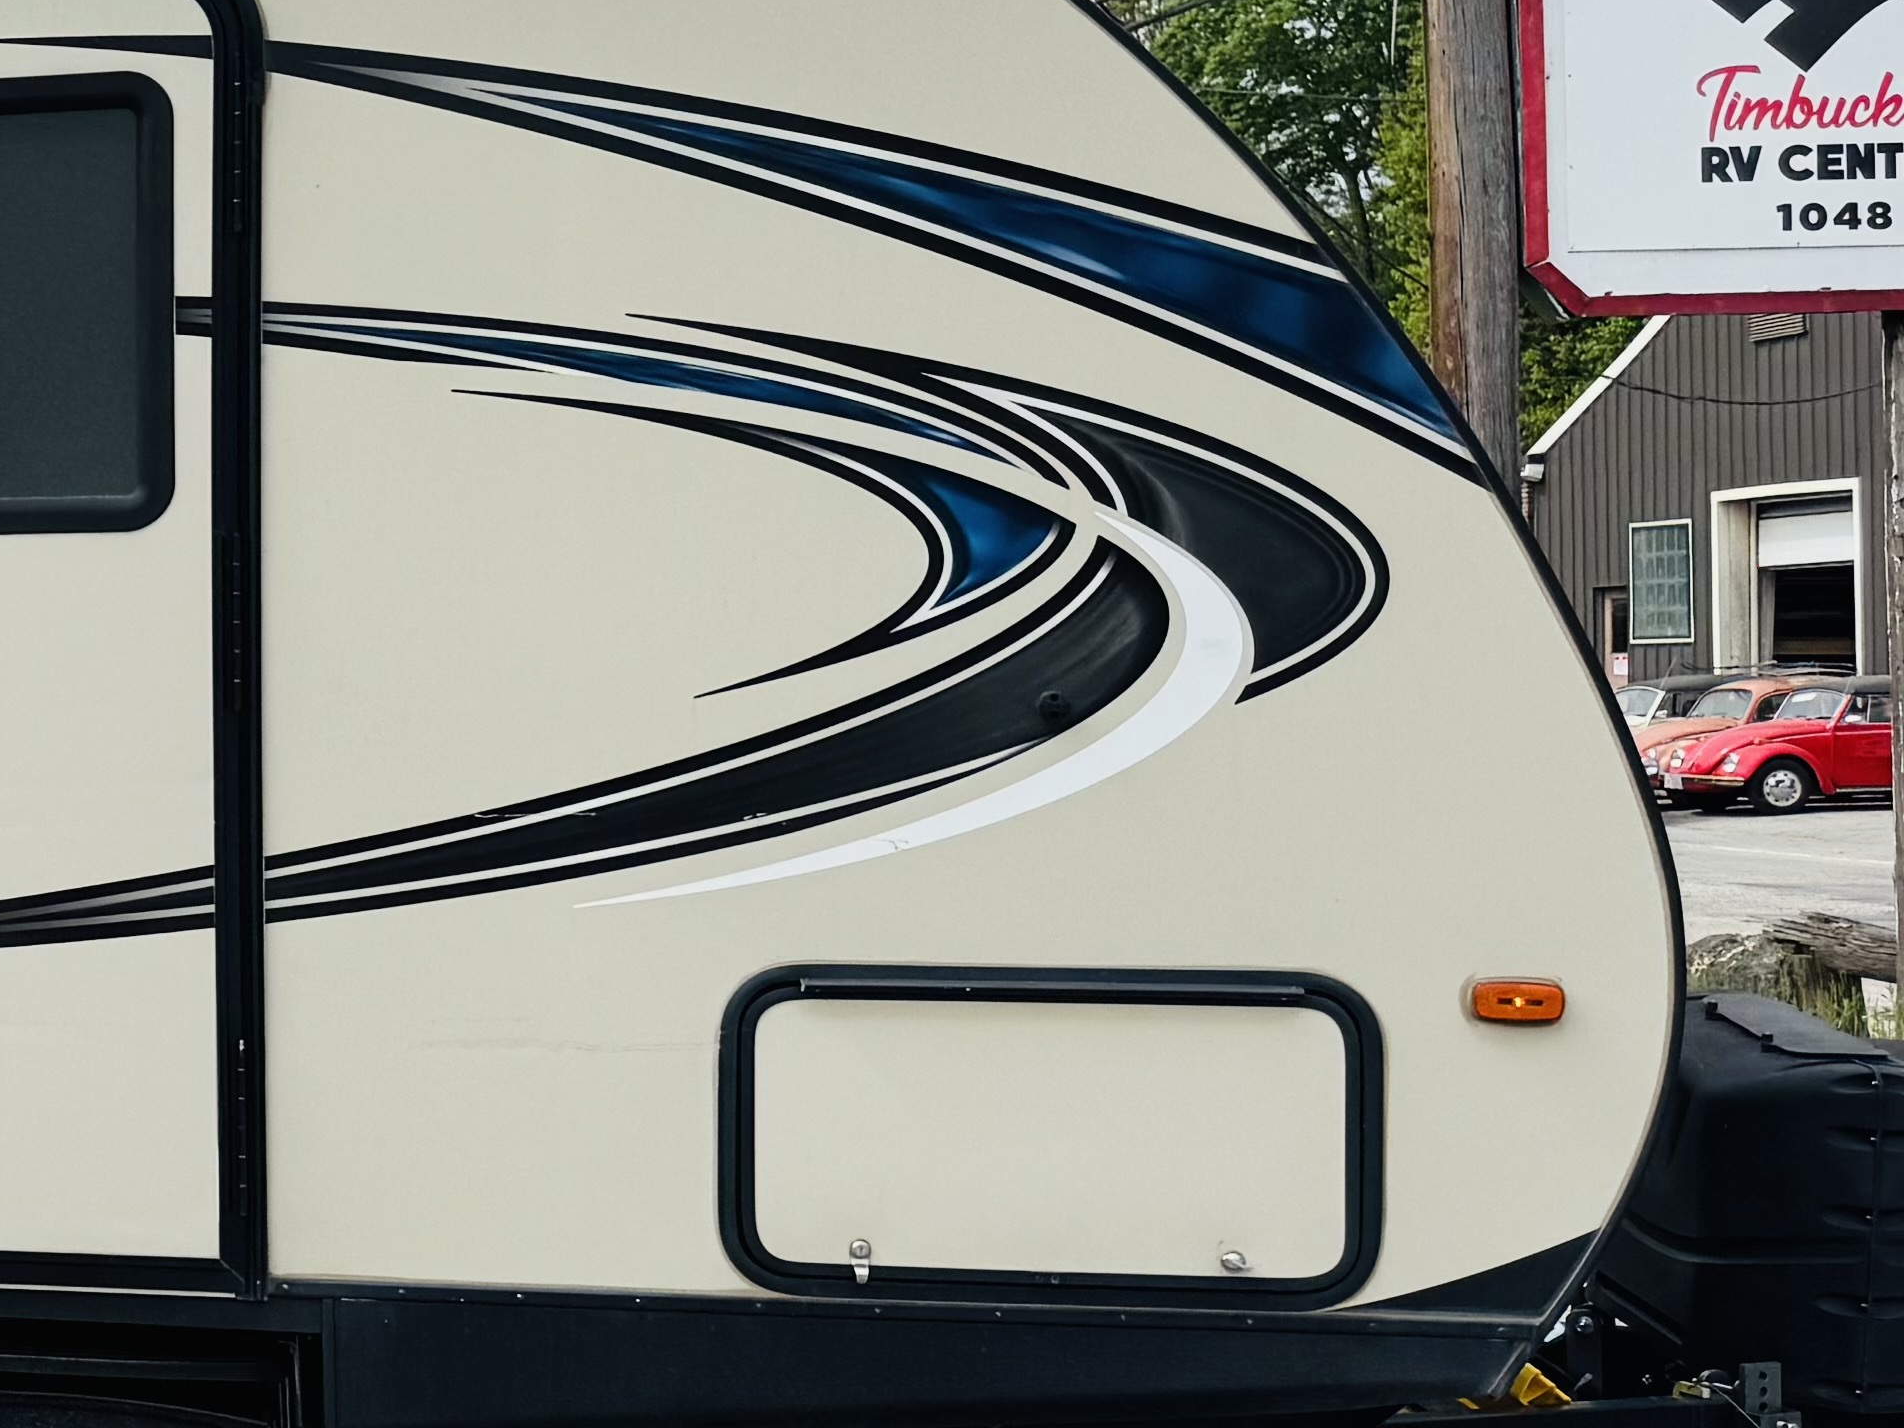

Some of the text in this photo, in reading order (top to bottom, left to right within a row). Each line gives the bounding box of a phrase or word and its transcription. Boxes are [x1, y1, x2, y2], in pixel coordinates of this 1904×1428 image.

[1697, 65, 1904, 142] Timbuck
[1701, 142, 1904, 183] RV CENT
[1776, 201, 1893, 231] 1048
